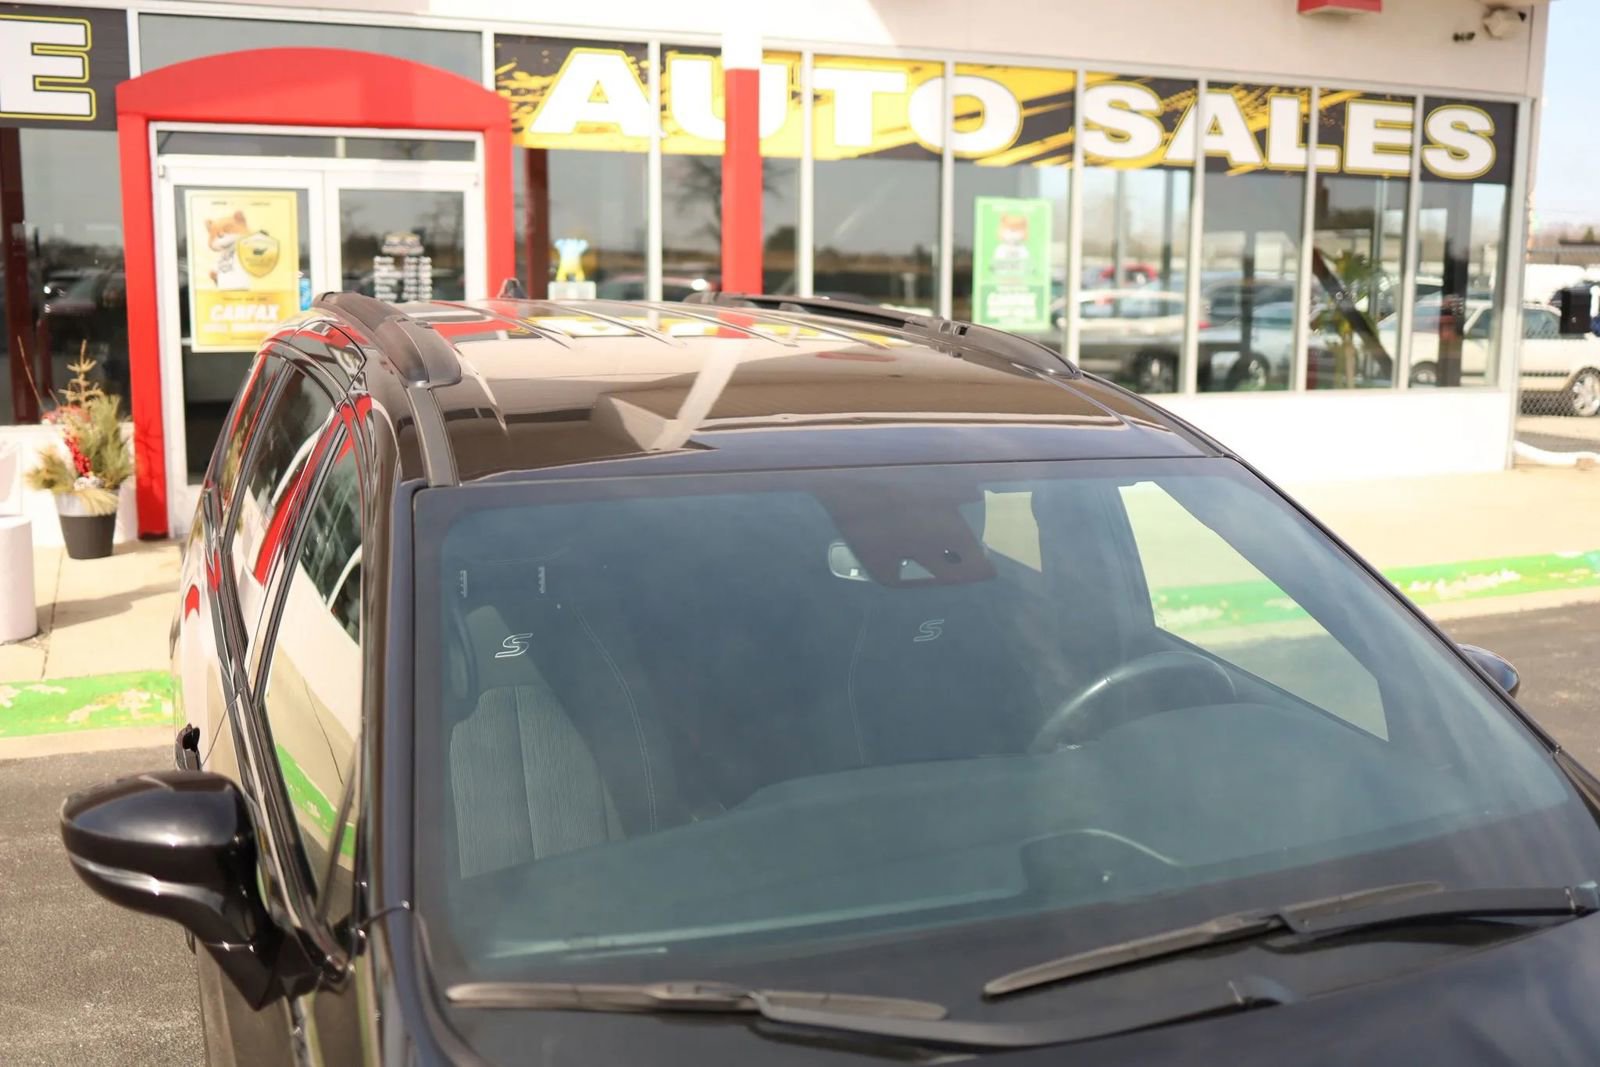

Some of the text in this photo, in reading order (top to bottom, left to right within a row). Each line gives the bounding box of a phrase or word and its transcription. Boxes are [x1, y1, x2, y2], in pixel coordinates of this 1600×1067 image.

[527, 46, 1024, 157] AUTO
[1082, 80, 1497, 180] SALES
[209, 303, 279, 323] CARFAX
[912, 618, 945, 642] S
[494, 632, 534, 659] S
